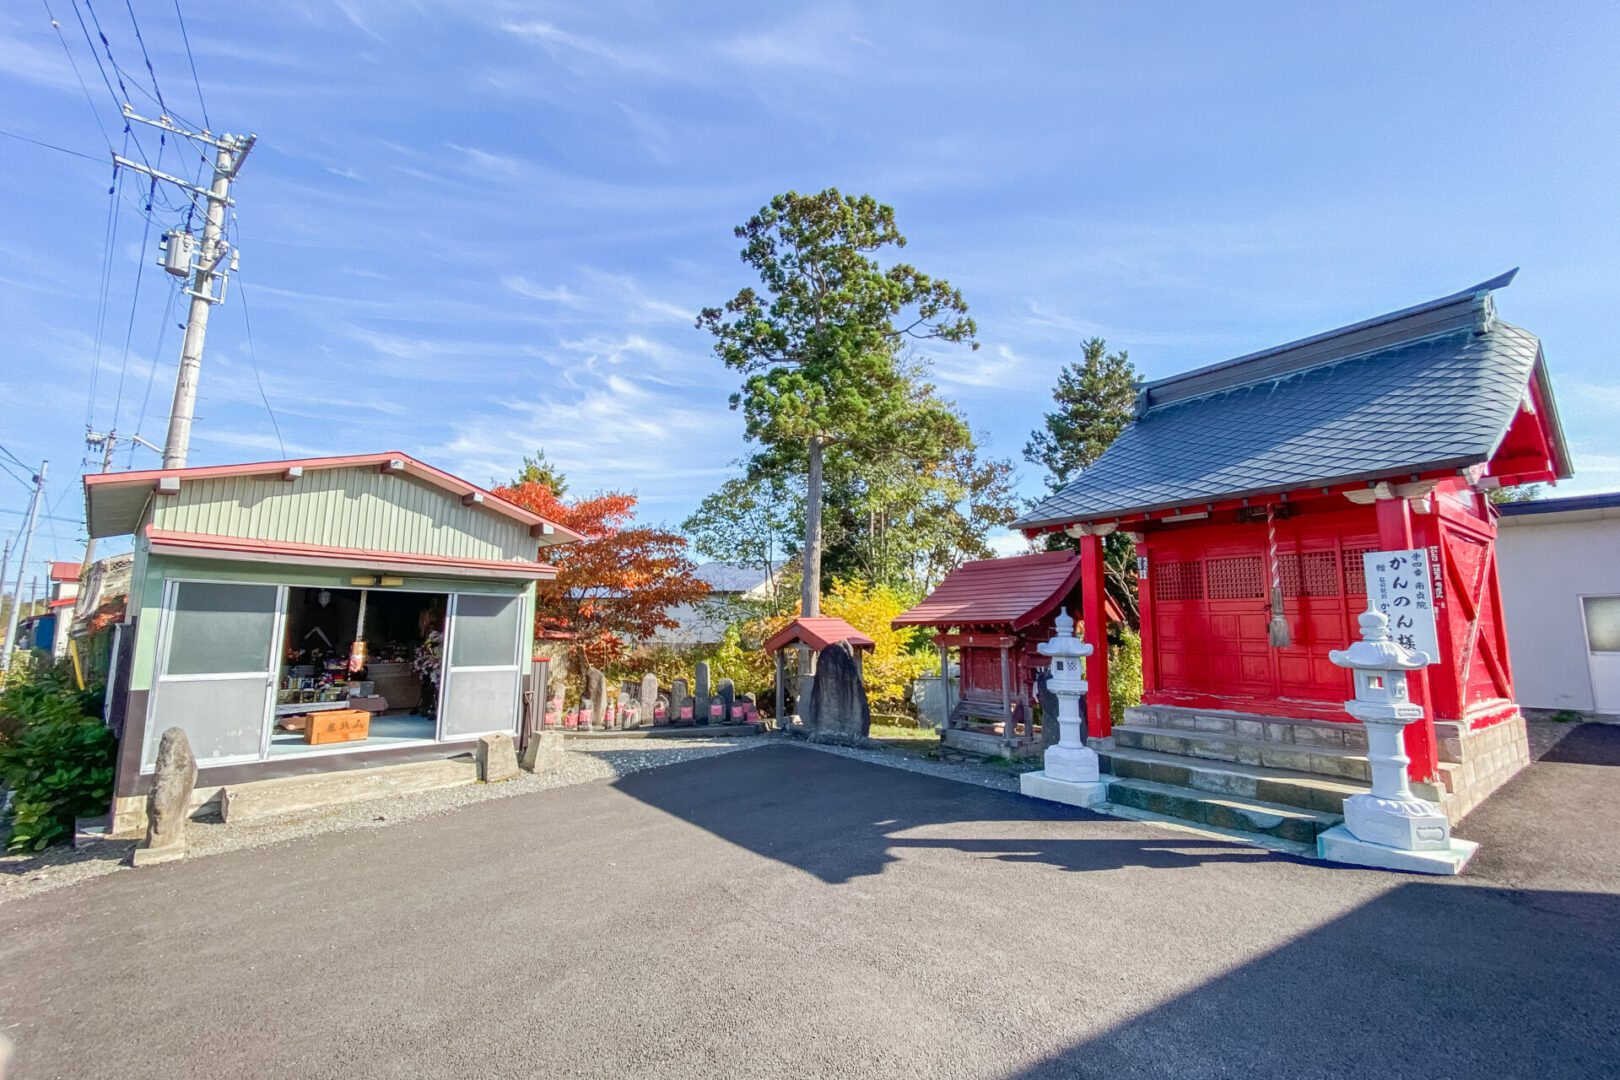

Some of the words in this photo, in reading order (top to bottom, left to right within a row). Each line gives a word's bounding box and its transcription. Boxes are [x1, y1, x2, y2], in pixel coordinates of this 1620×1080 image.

[1389, 557, 1416, 650] かんのん様
